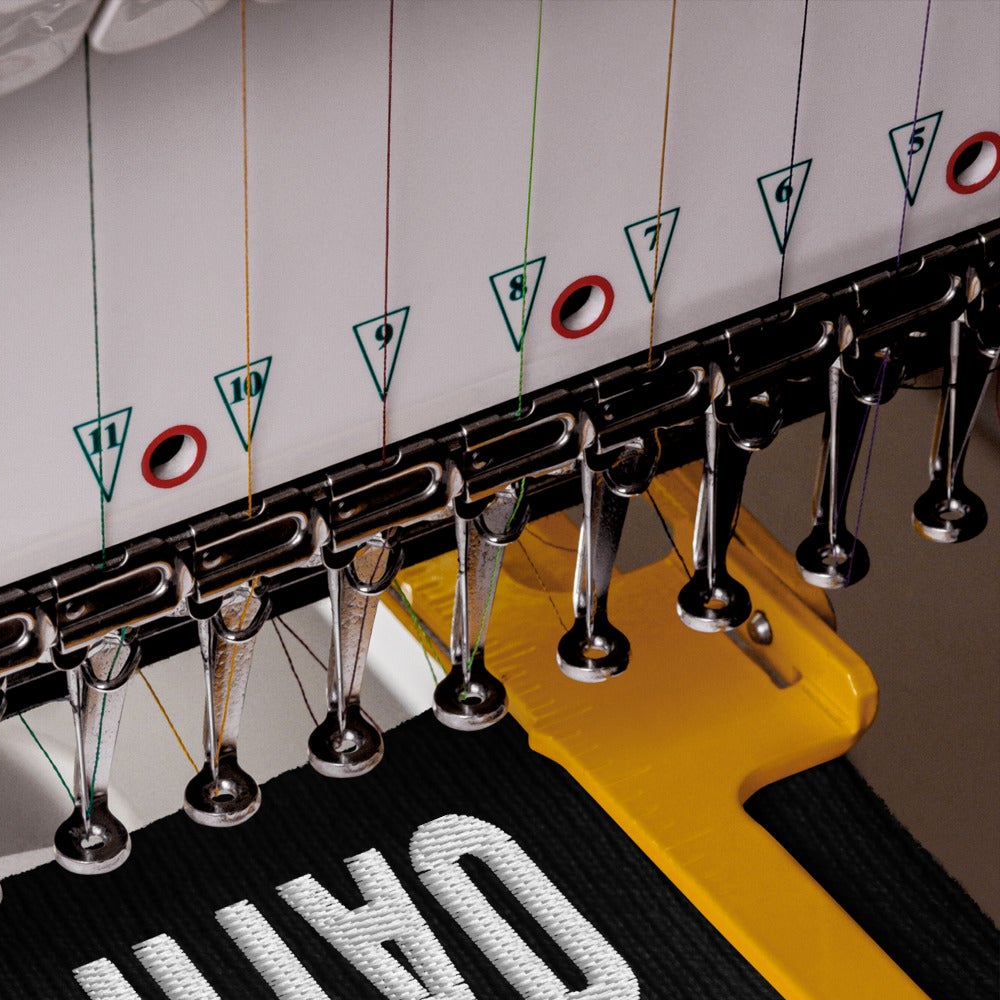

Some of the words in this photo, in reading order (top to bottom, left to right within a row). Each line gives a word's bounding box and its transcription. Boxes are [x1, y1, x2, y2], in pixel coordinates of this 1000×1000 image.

[907, 127, 926, 156] 5
[774, 175, 793, 203] 6
[643, 223, 662, 251] 7
[508, 273, 528, 301] 8
[374, 322, 394, 351] 9
[229, 371, 262, 405] 10
[87, 421, 122, 456] 11
